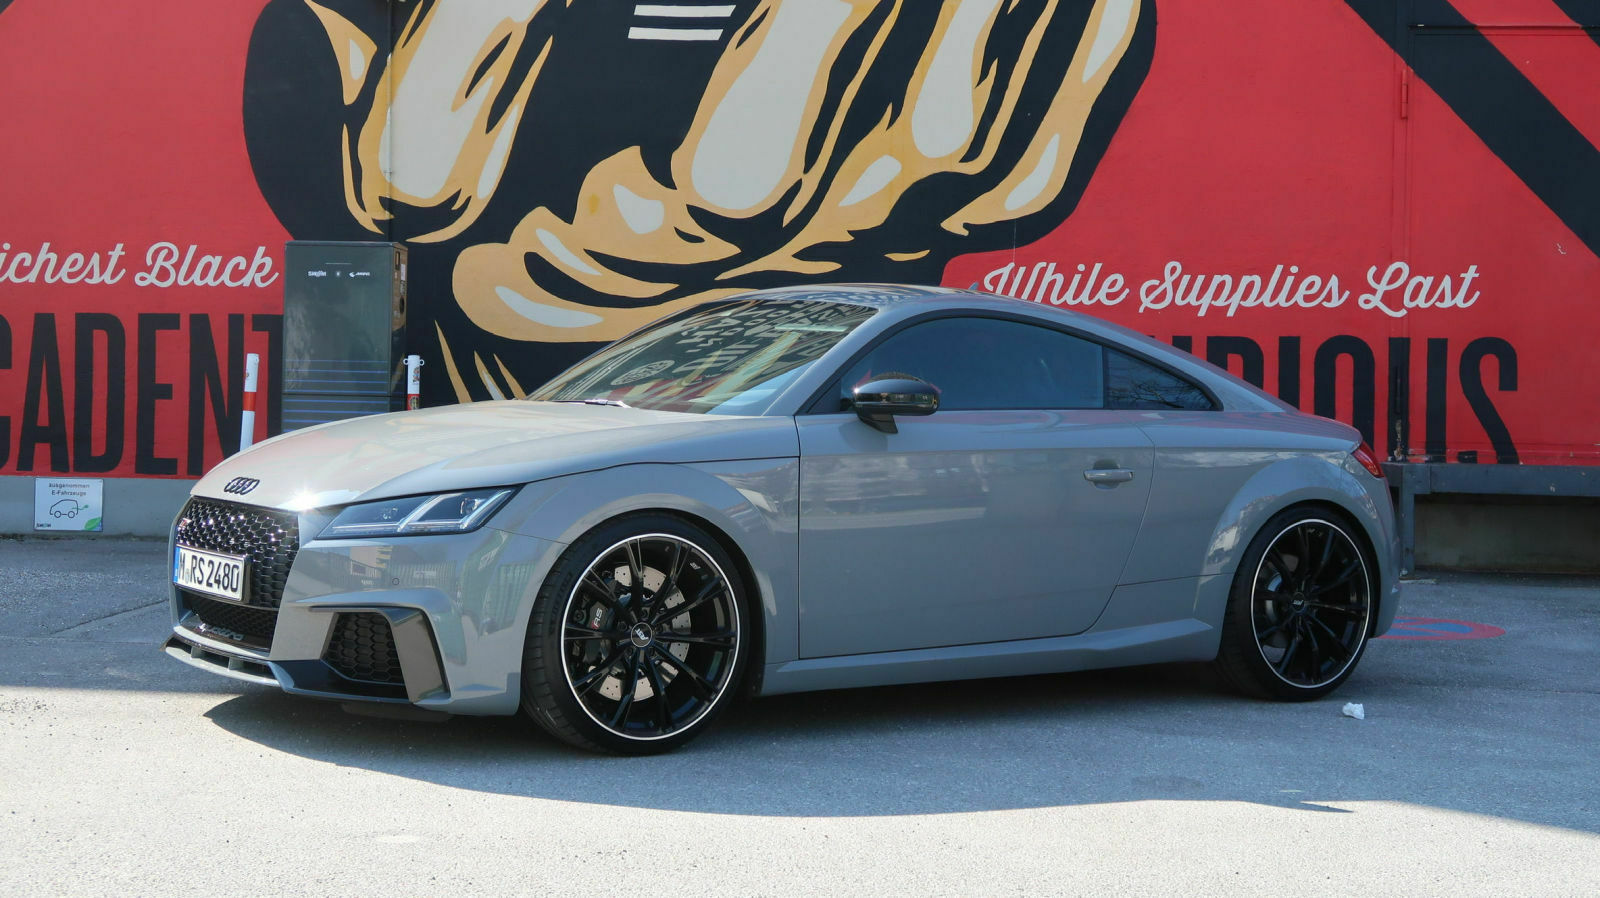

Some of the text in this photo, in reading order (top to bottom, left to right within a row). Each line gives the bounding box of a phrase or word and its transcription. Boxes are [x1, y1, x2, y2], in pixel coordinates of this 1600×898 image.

[135, 241, 279, 288] Black
[984, 261, 1481, 318] While Supplies Last
[0, 312, 281, 476] ADENT
[178, 552, 240, 593] M RS 2480
